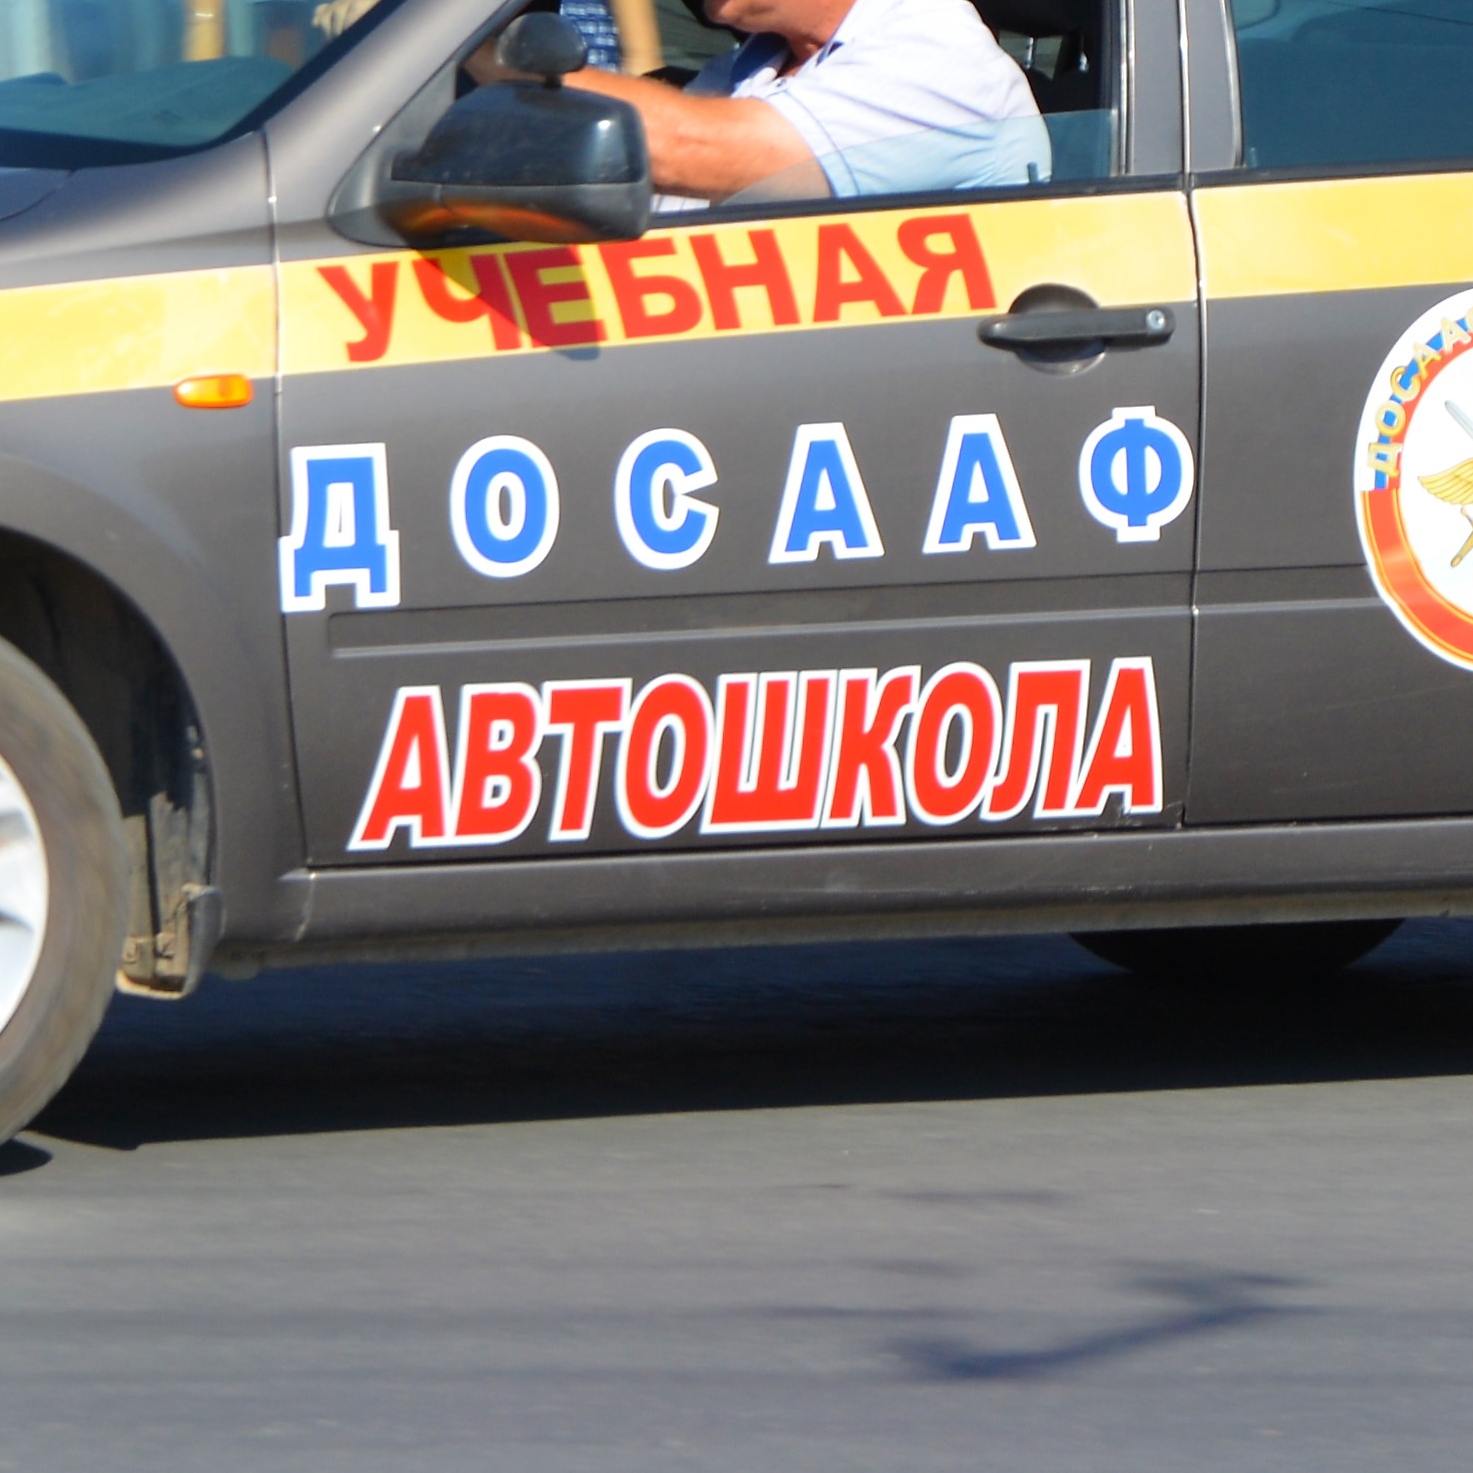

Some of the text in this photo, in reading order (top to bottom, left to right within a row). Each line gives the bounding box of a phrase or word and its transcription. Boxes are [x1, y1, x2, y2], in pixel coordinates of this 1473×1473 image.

[316, 212, 999, 363] УЧЕБНАЯ
[279, 405, 1195, 613] ДОСААФ
[347, 657, 1165, 851] АВТОШКОЛА
